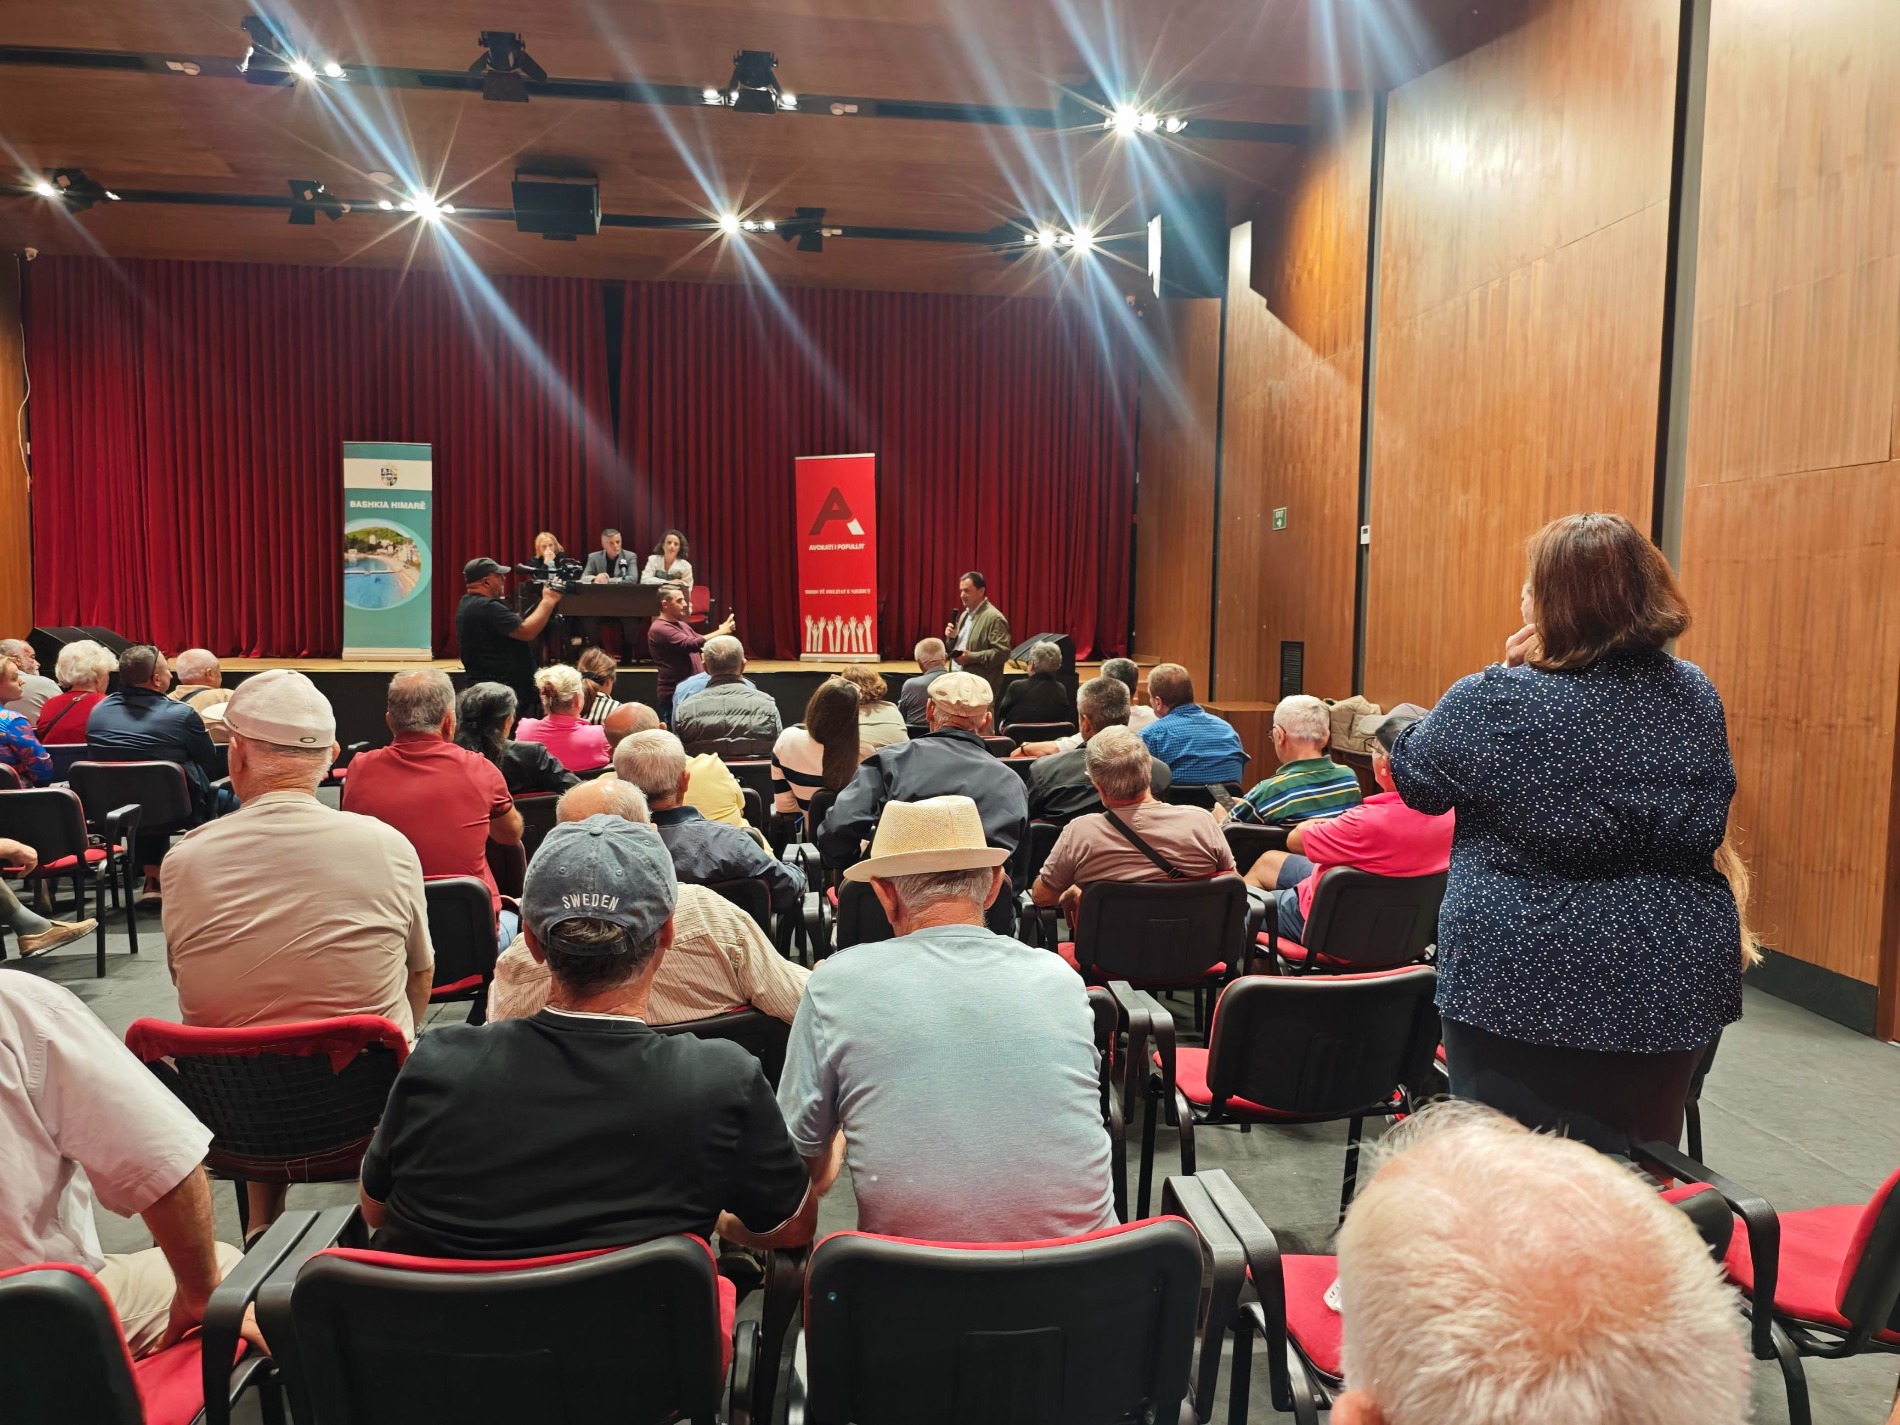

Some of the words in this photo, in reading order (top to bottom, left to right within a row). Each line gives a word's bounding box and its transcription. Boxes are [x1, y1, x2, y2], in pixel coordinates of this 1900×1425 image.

[349, 500, 390, 509] BASHKIA
[391, 501, 427, 510] HIMARË
[561, 893, 620, 911] SWEDEN
